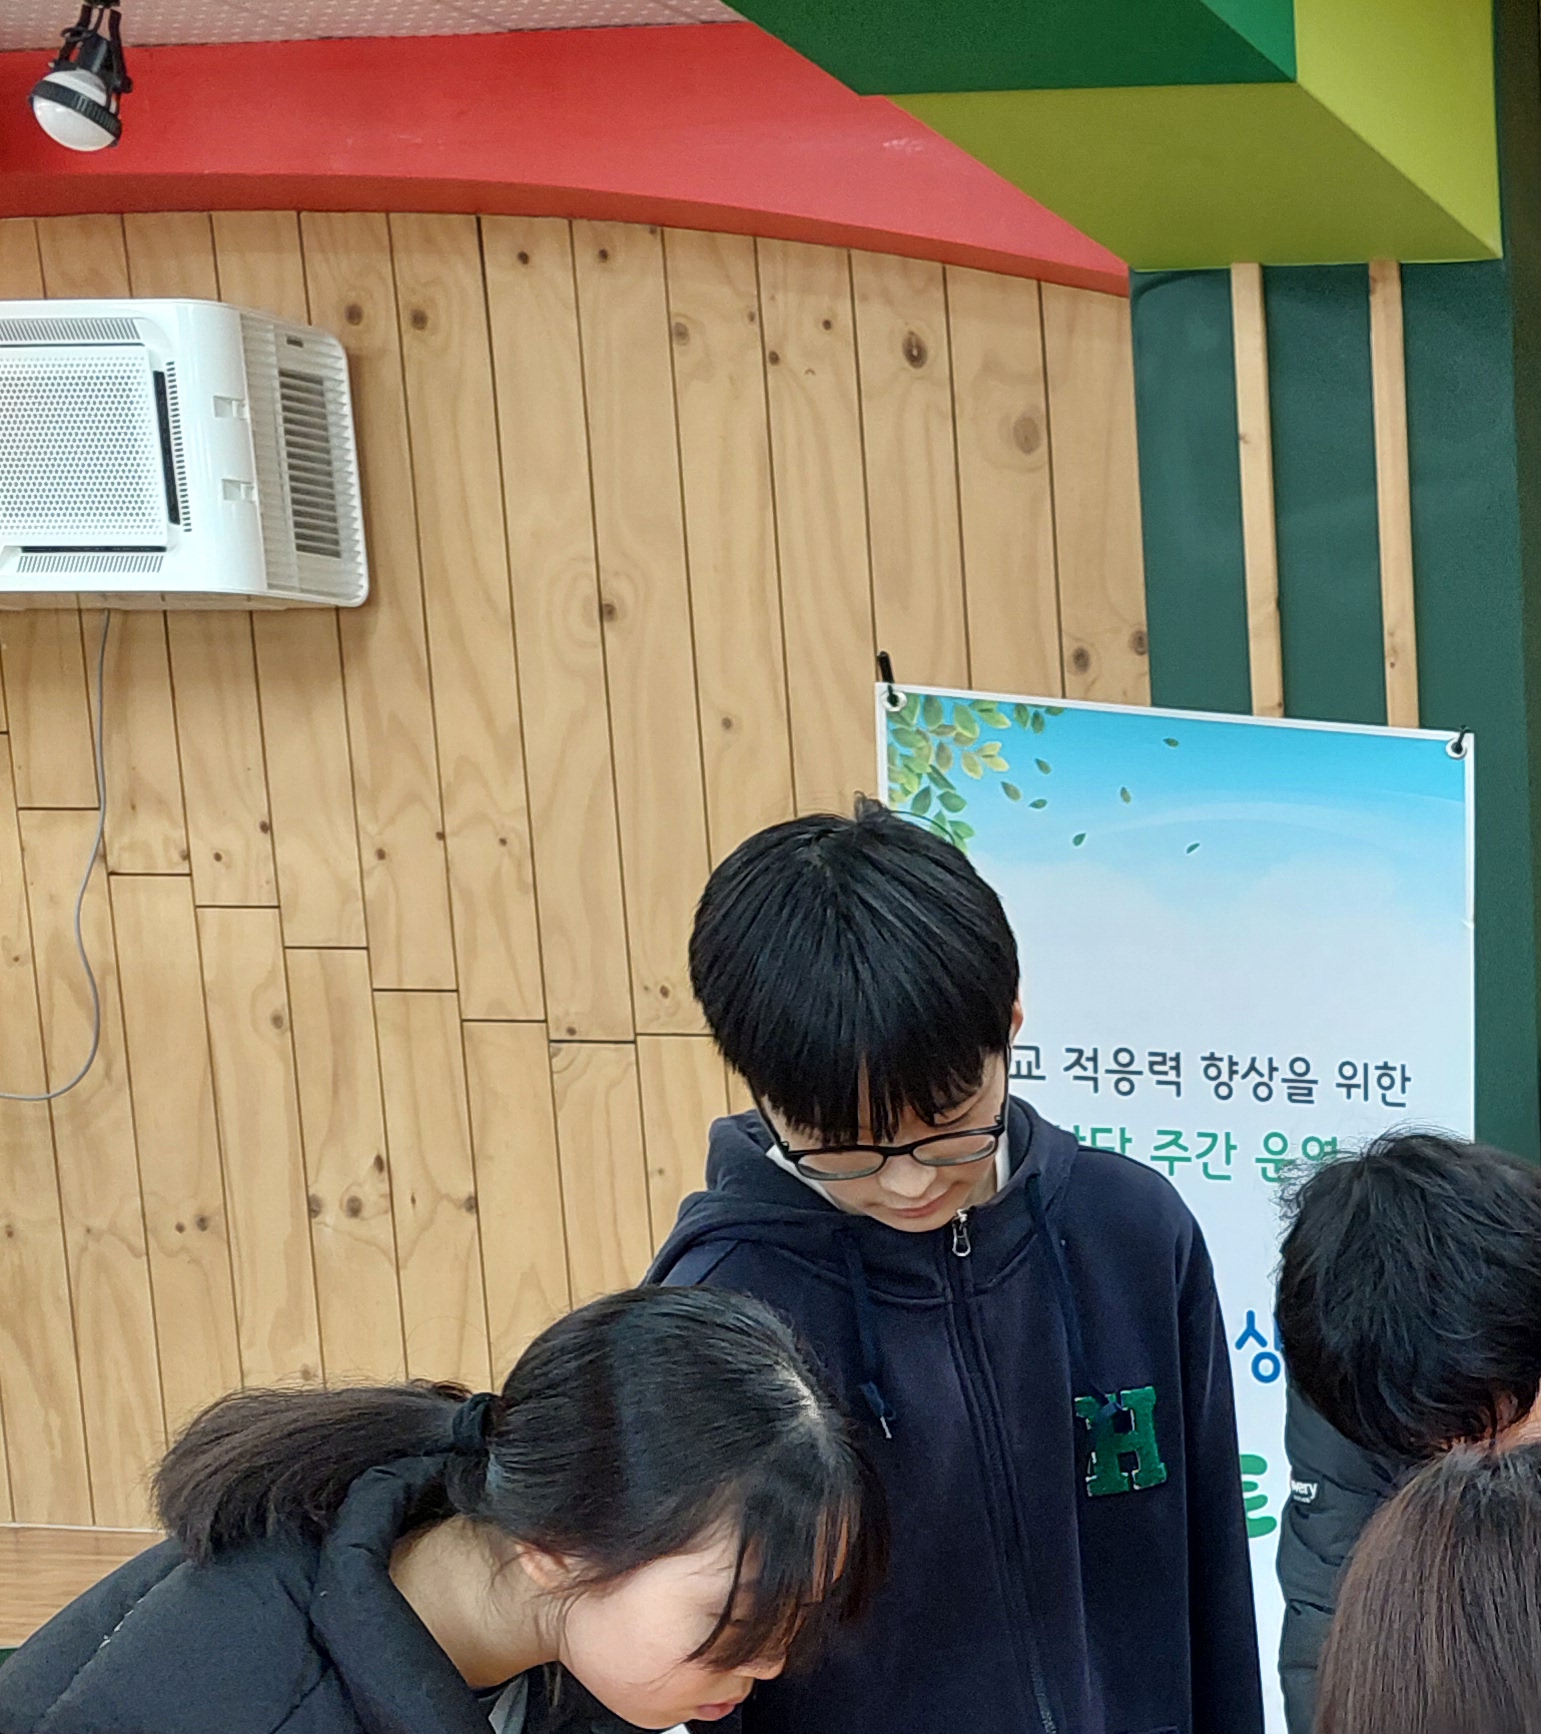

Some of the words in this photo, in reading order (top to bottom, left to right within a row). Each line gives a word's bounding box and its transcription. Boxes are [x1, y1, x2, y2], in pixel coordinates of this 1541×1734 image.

[1062, 1046, 1182, 1098] 적응력
[1200, 1053, 1319, 1105] 향상을
[1335, 1059, 1411, 1108] 위한
[1150, 1128, 1237, 1181] 주간
[1076, 1387, 1168, 1498] H
